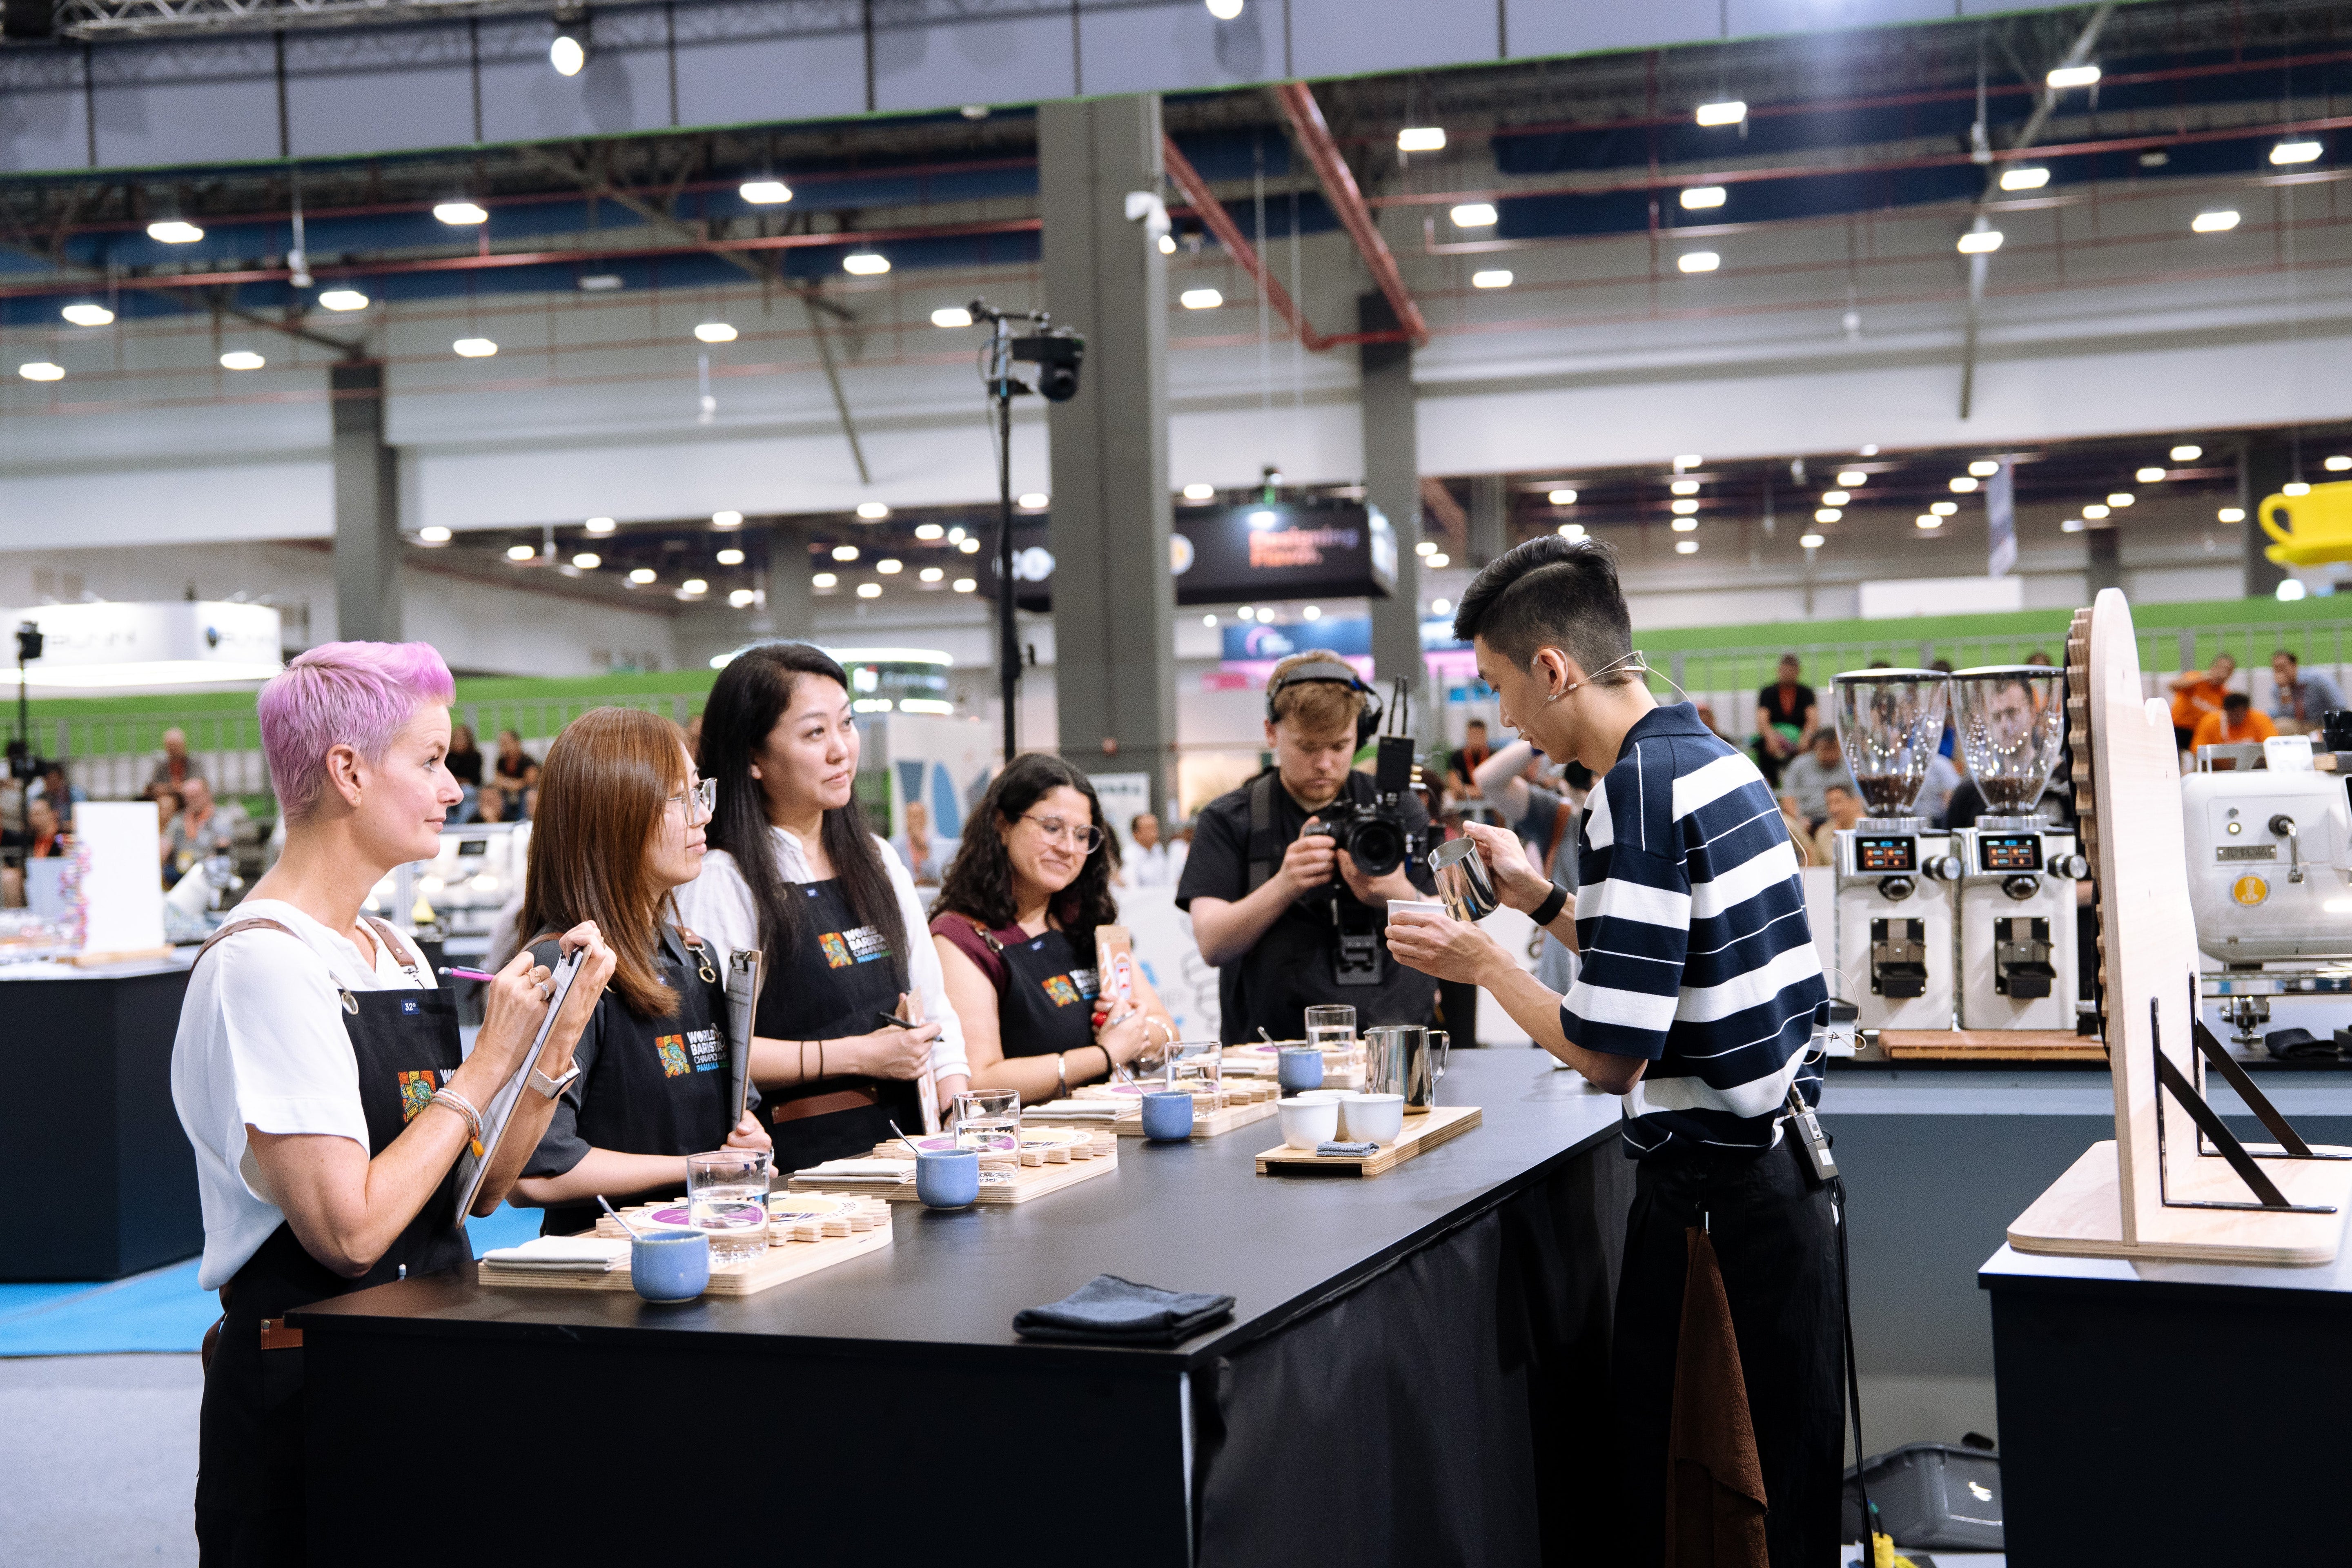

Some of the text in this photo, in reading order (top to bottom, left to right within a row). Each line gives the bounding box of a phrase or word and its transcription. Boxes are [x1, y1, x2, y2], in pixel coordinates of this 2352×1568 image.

[686, 1029, 716, 1044] WORLD
[690, 1041, 722, 1056] BARISTA
[696, 1062, 719, 1073] PANAMA
